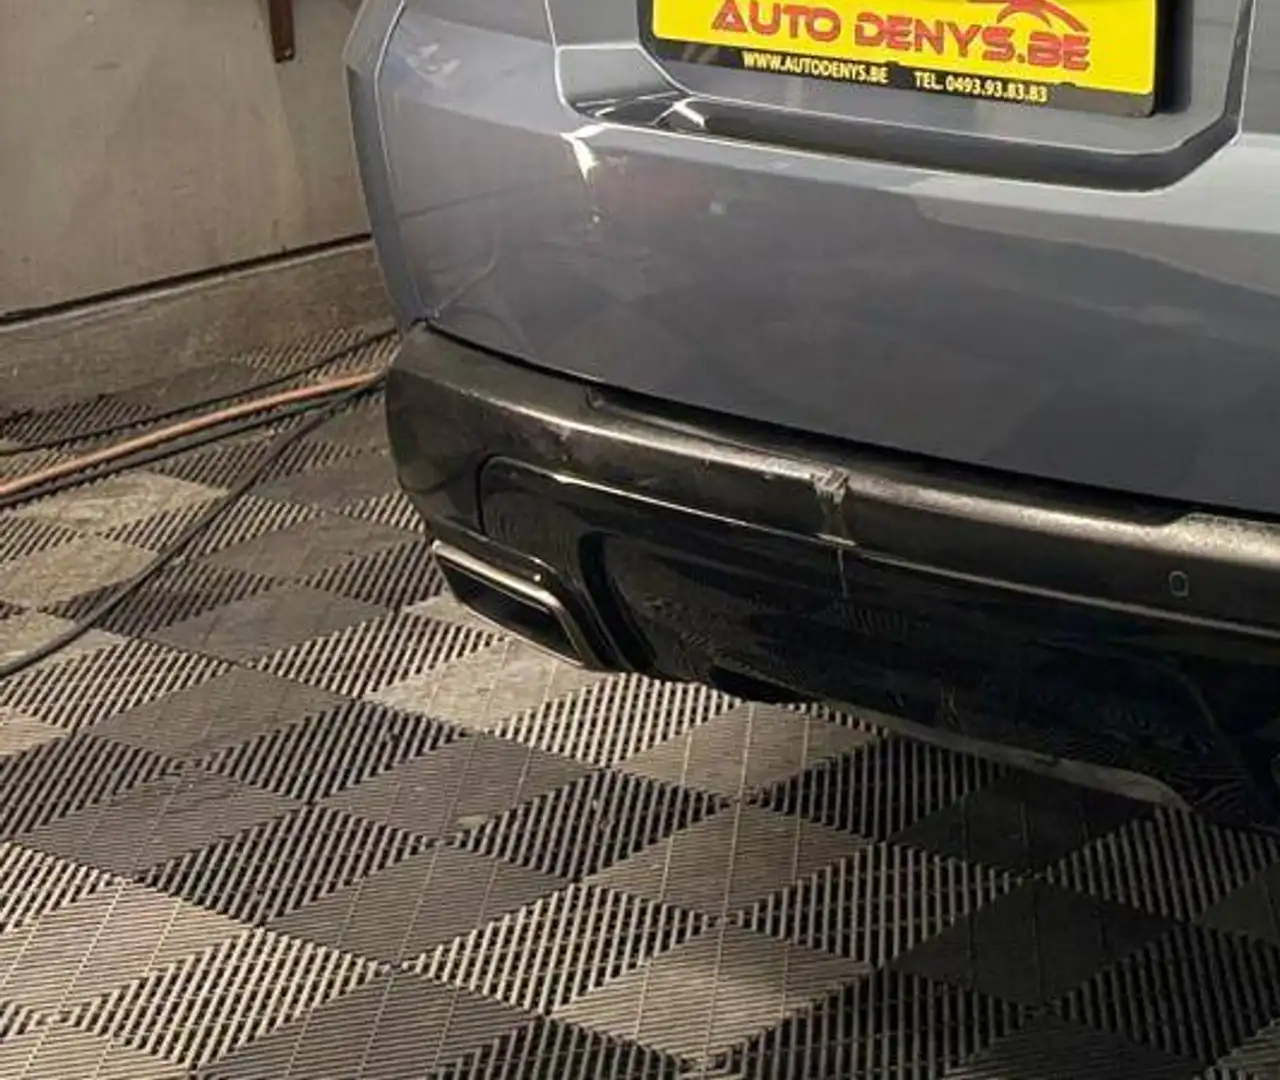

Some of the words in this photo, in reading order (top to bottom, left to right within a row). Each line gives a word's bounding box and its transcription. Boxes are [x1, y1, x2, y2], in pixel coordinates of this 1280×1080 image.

[853, 11, 1091, 72] DENYS.BE
[742, 50, 889, 86] WWW.AUTODENYS.BE
[914, 70, 944, 93] TEL.
[945, 74, 1049, 104] 0493.93.83.83
